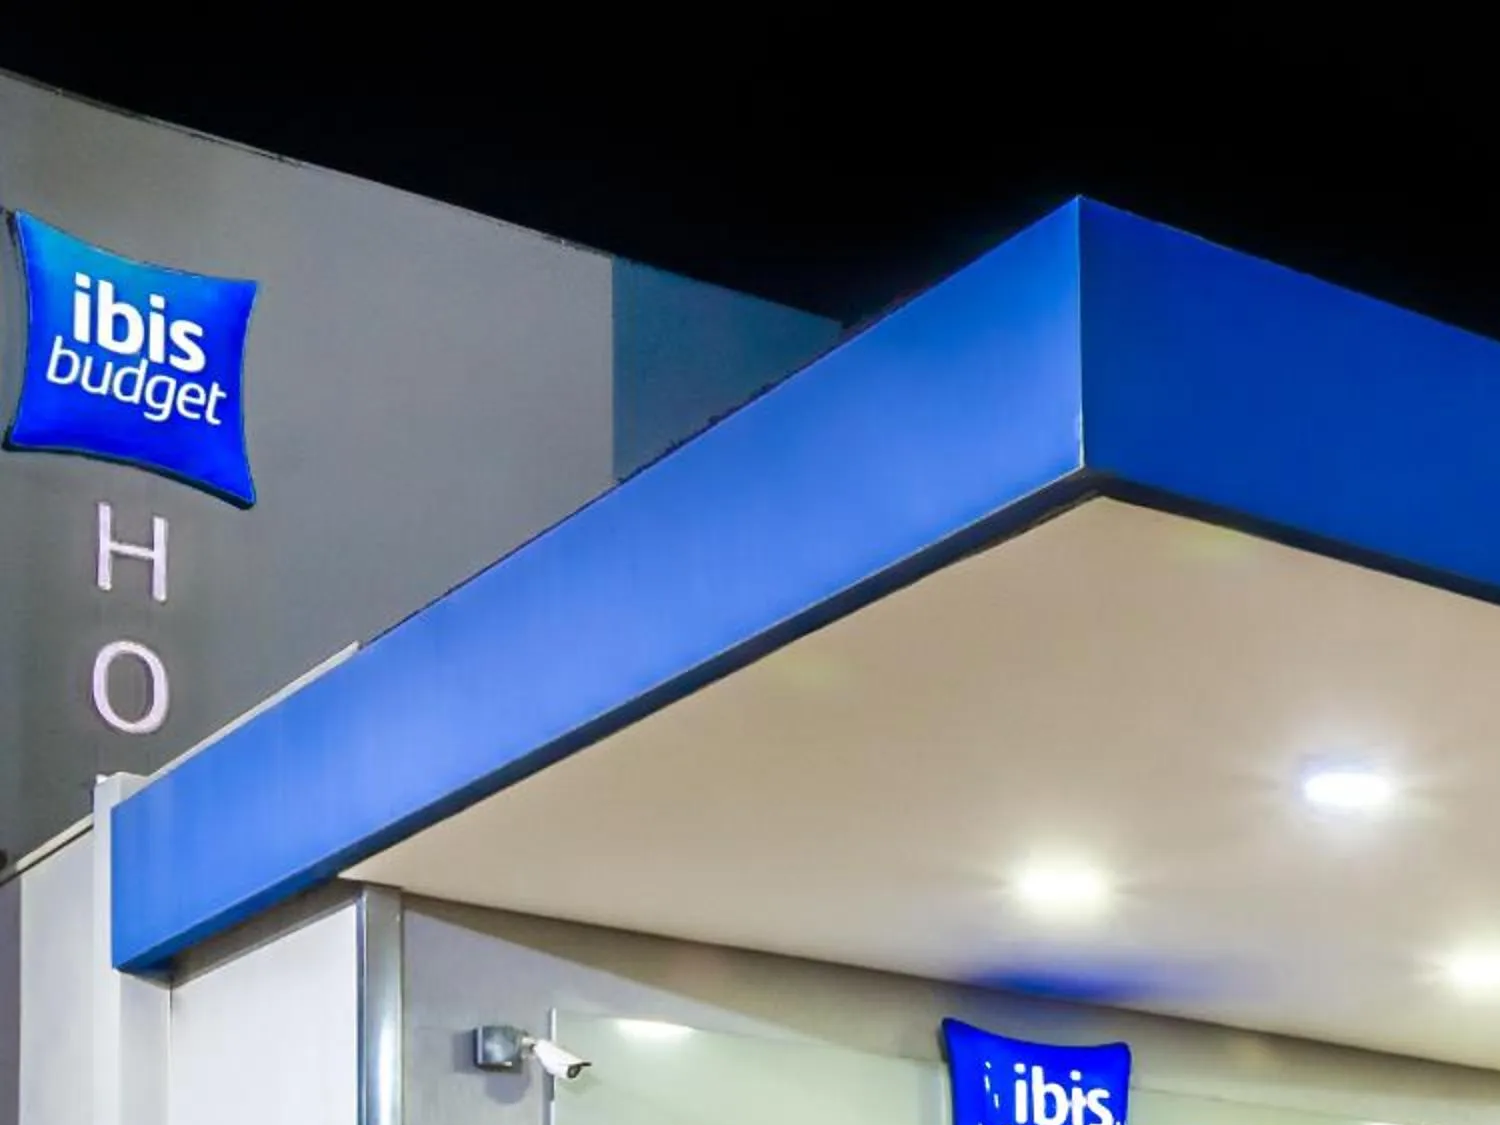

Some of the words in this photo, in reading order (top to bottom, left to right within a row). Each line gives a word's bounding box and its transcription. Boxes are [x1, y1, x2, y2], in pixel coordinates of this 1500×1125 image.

[73, 271, 206, 374] ibis
[46, 336, 226, 425] budget
[92, 502, 170, 784] HO
